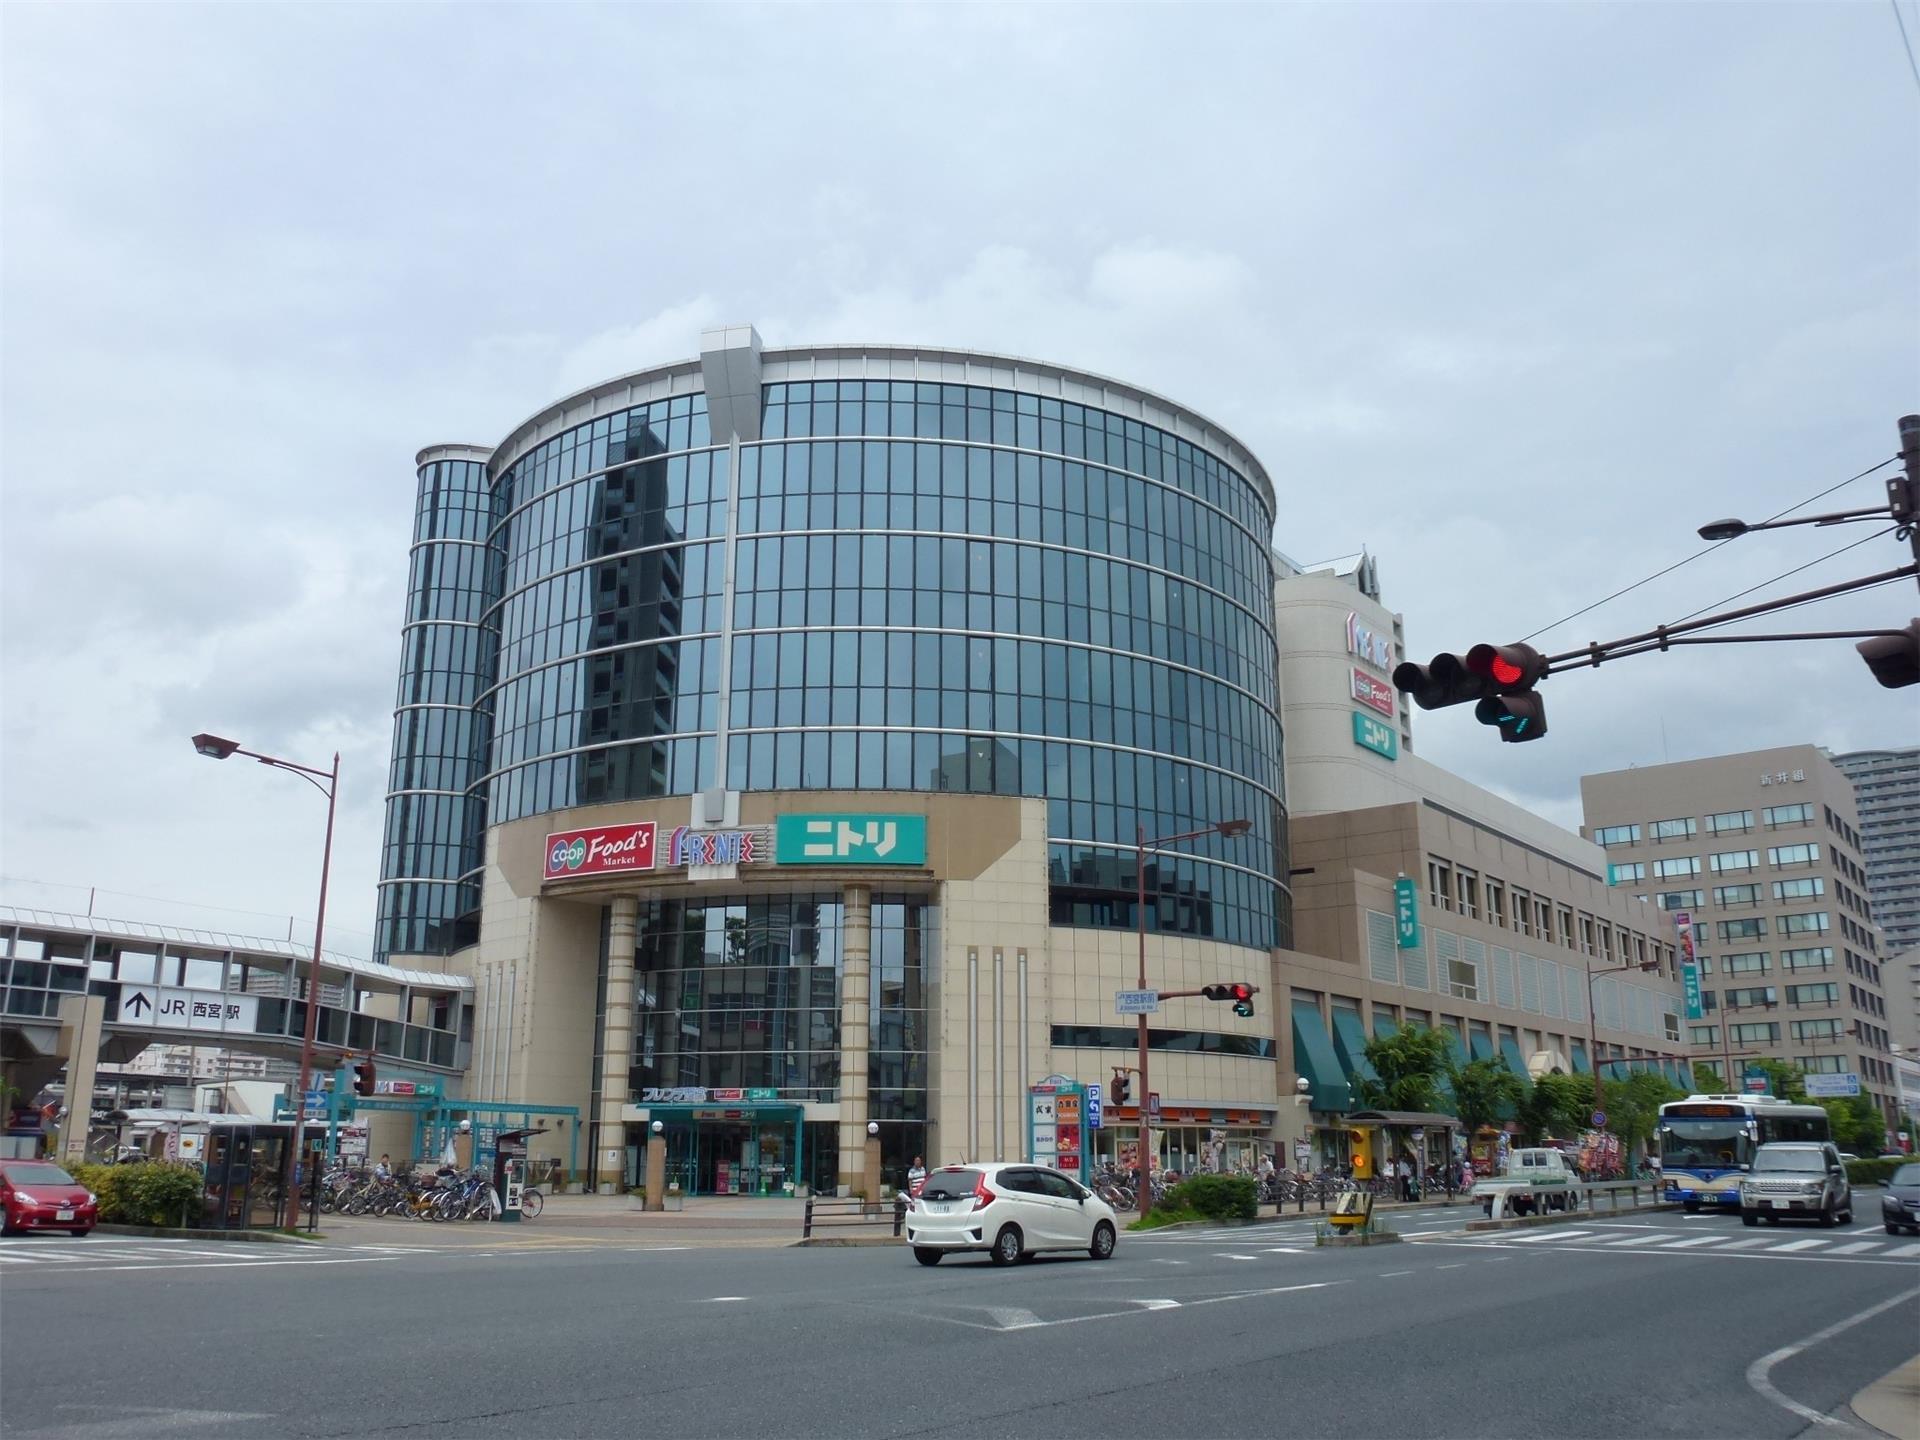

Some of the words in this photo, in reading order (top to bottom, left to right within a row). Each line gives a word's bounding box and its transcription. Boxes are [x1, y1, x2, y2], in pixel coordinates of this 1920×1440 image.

[1364, 720, 1389, 750] ニトリ
[552, 847, 583, 862] COOP
[587, 830, 650, 863] Food's
[668, 825, 754, 866] FRENTE
[804, 821, 897, 857] ニトリ
[603, 856, 635, 866] Market
[1399, 889, 1413, 937] ニトリ
[1686, 975, 1698, 1008] ニトリ
[160, 999, 185, 1015] JR
[193, 1002, 240, 1020] 西宮駅
[752, 1088, 770, 1097] ニトリ
[1090, 1089, 1098, 1099] P
